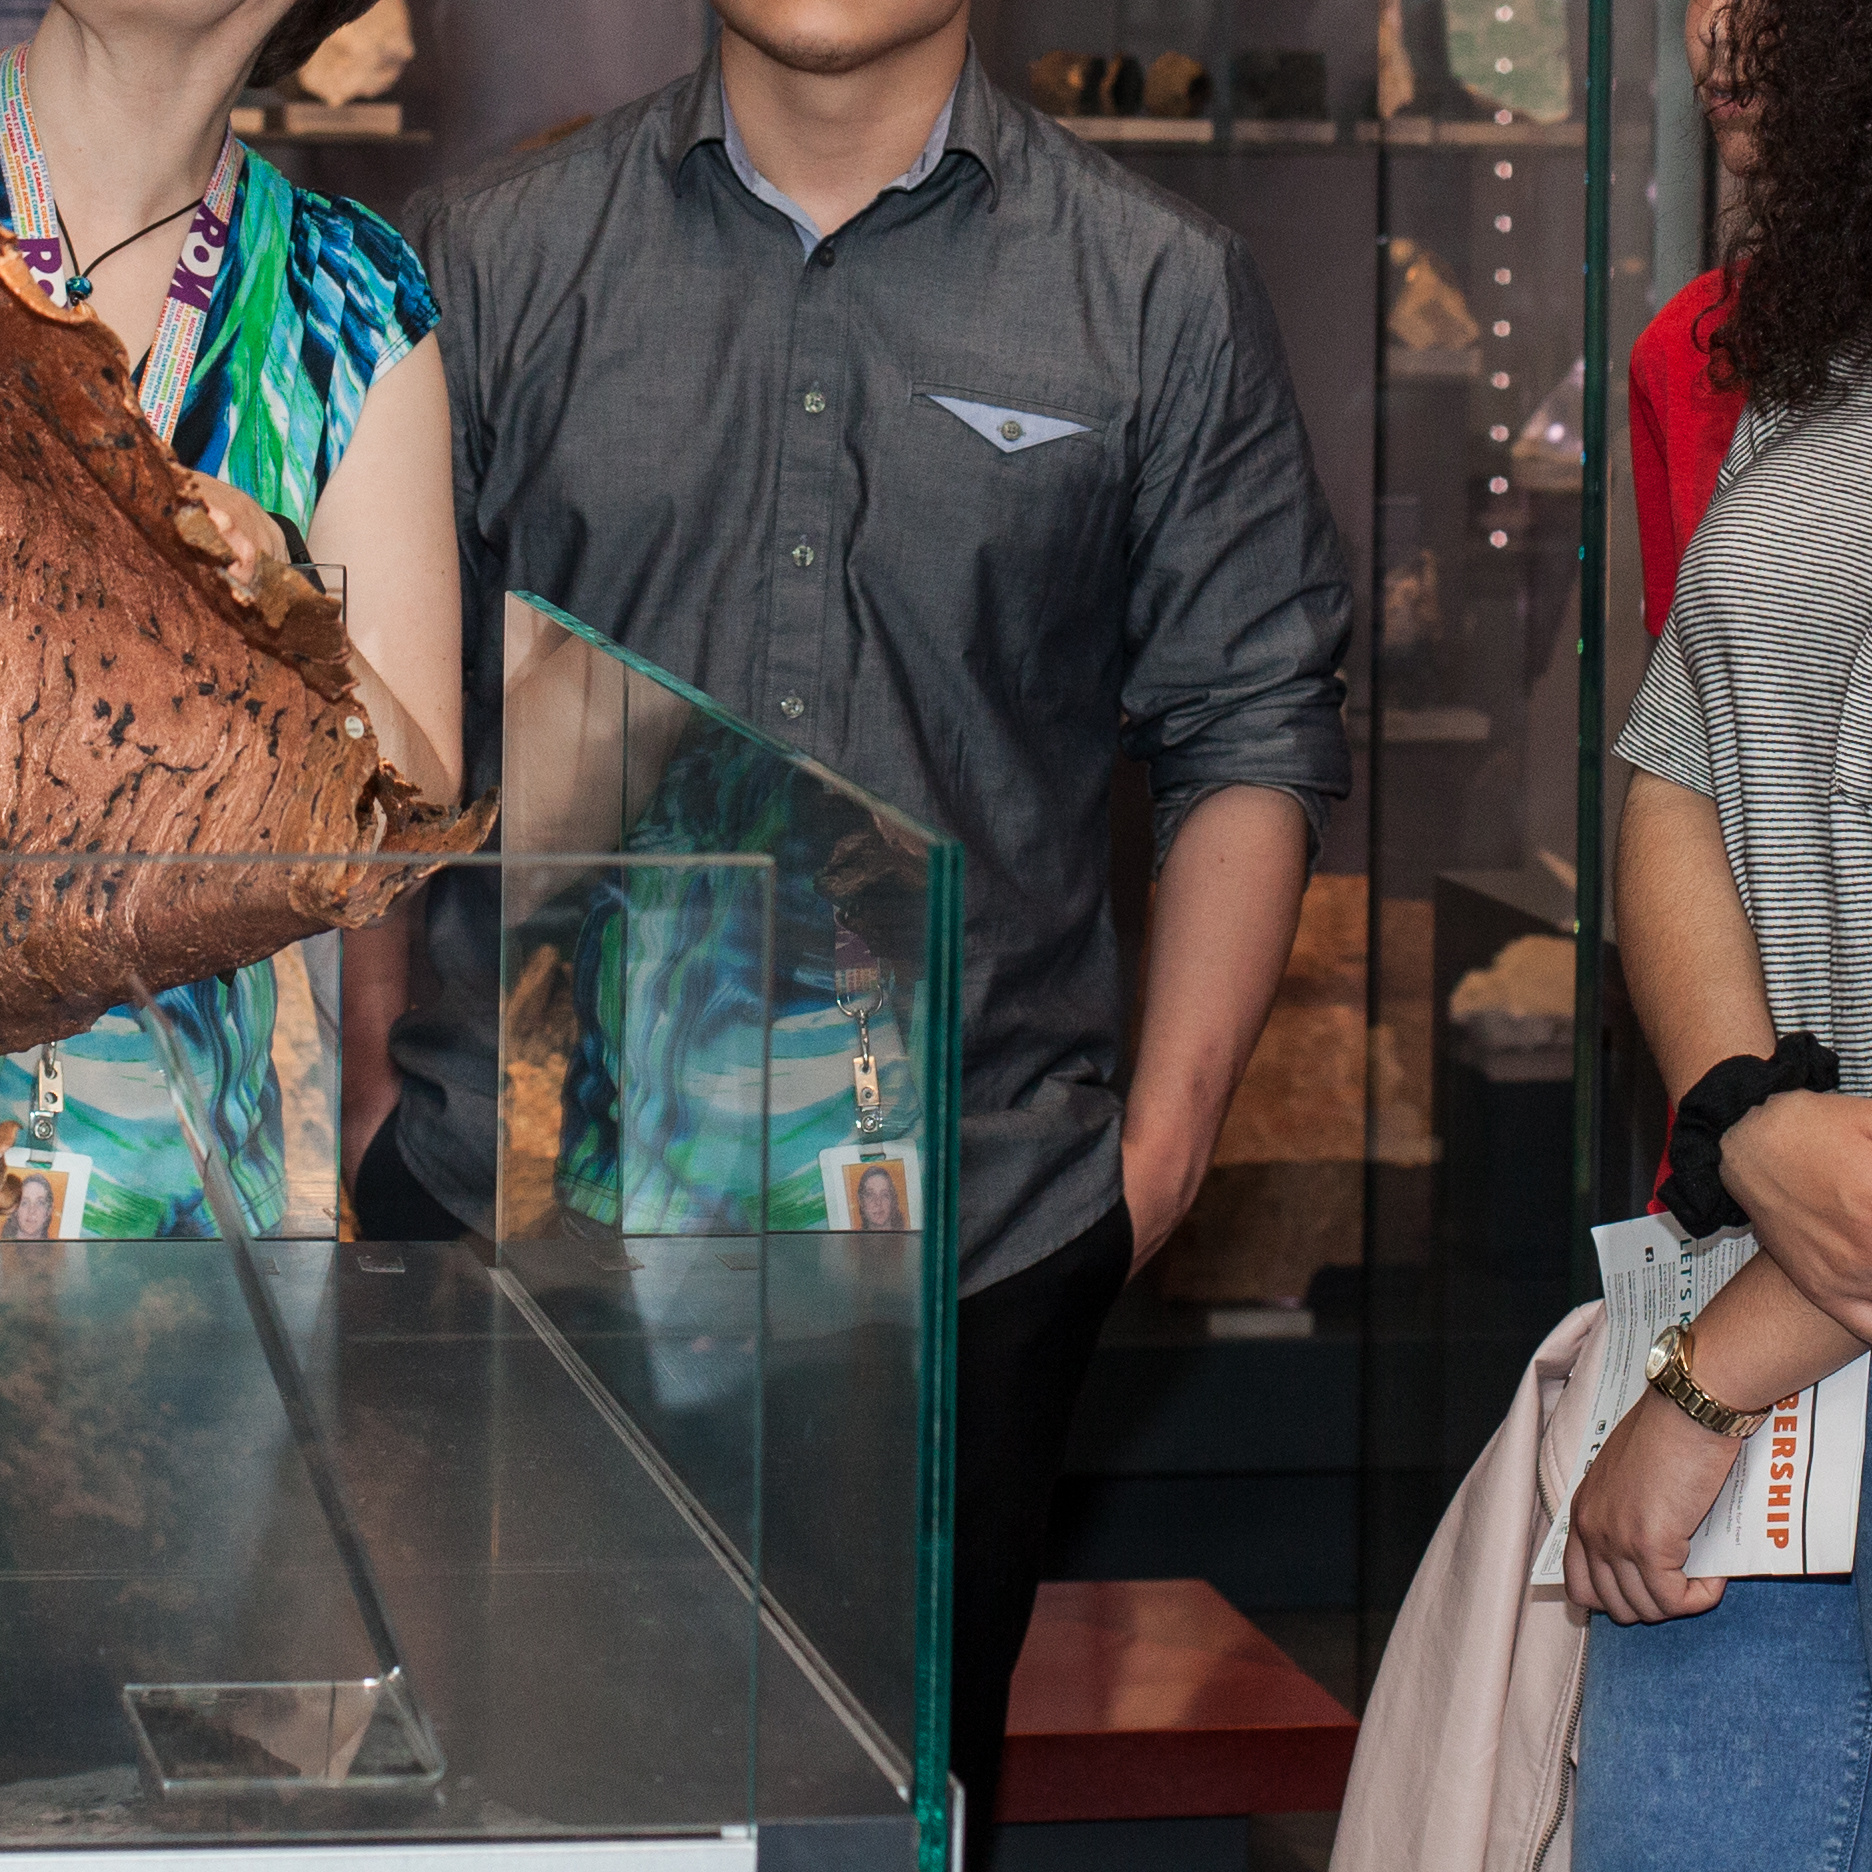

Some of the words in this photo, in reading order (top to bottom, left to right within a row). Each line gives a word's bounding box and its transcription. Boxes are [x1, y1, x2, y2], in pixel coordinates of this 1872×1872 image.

[9, 100, 18, 121] MODE
[14, 122, 20, 130] ET
[15, 98, 36, 160] CONTEMPORAINE
[6, 123, 18, 153] CANADA
[15, 155, 27, 190] CULTURES
[16, 132, 29, 164] TEXTILES
[31, 162, 38, 170] LE
[25, 166, 36, 197] CULTURE
[34, 171, 45, 203] CANADA
[38, 154, 47, 173] ARTS
[45, 184, 56, 222] CULTURES
[167, 201, 228, 313] ROM
[160, 332, 168, 343] DU
[166, 324, 178, 352] CULTURE
[187, 317, 196, 337] MODE
[152, 343, 165, 369] MONDE
[184, 338, 190, 346] ET
[187, 352, 194, 360] LE
[149, 354, 170, 410] CONTEMPORAINE
[180, 361, 192, 387] CANADA
[167, 376, 179, 404] CULTURE
[1680, 1238, 1693, 1302] LET'S
